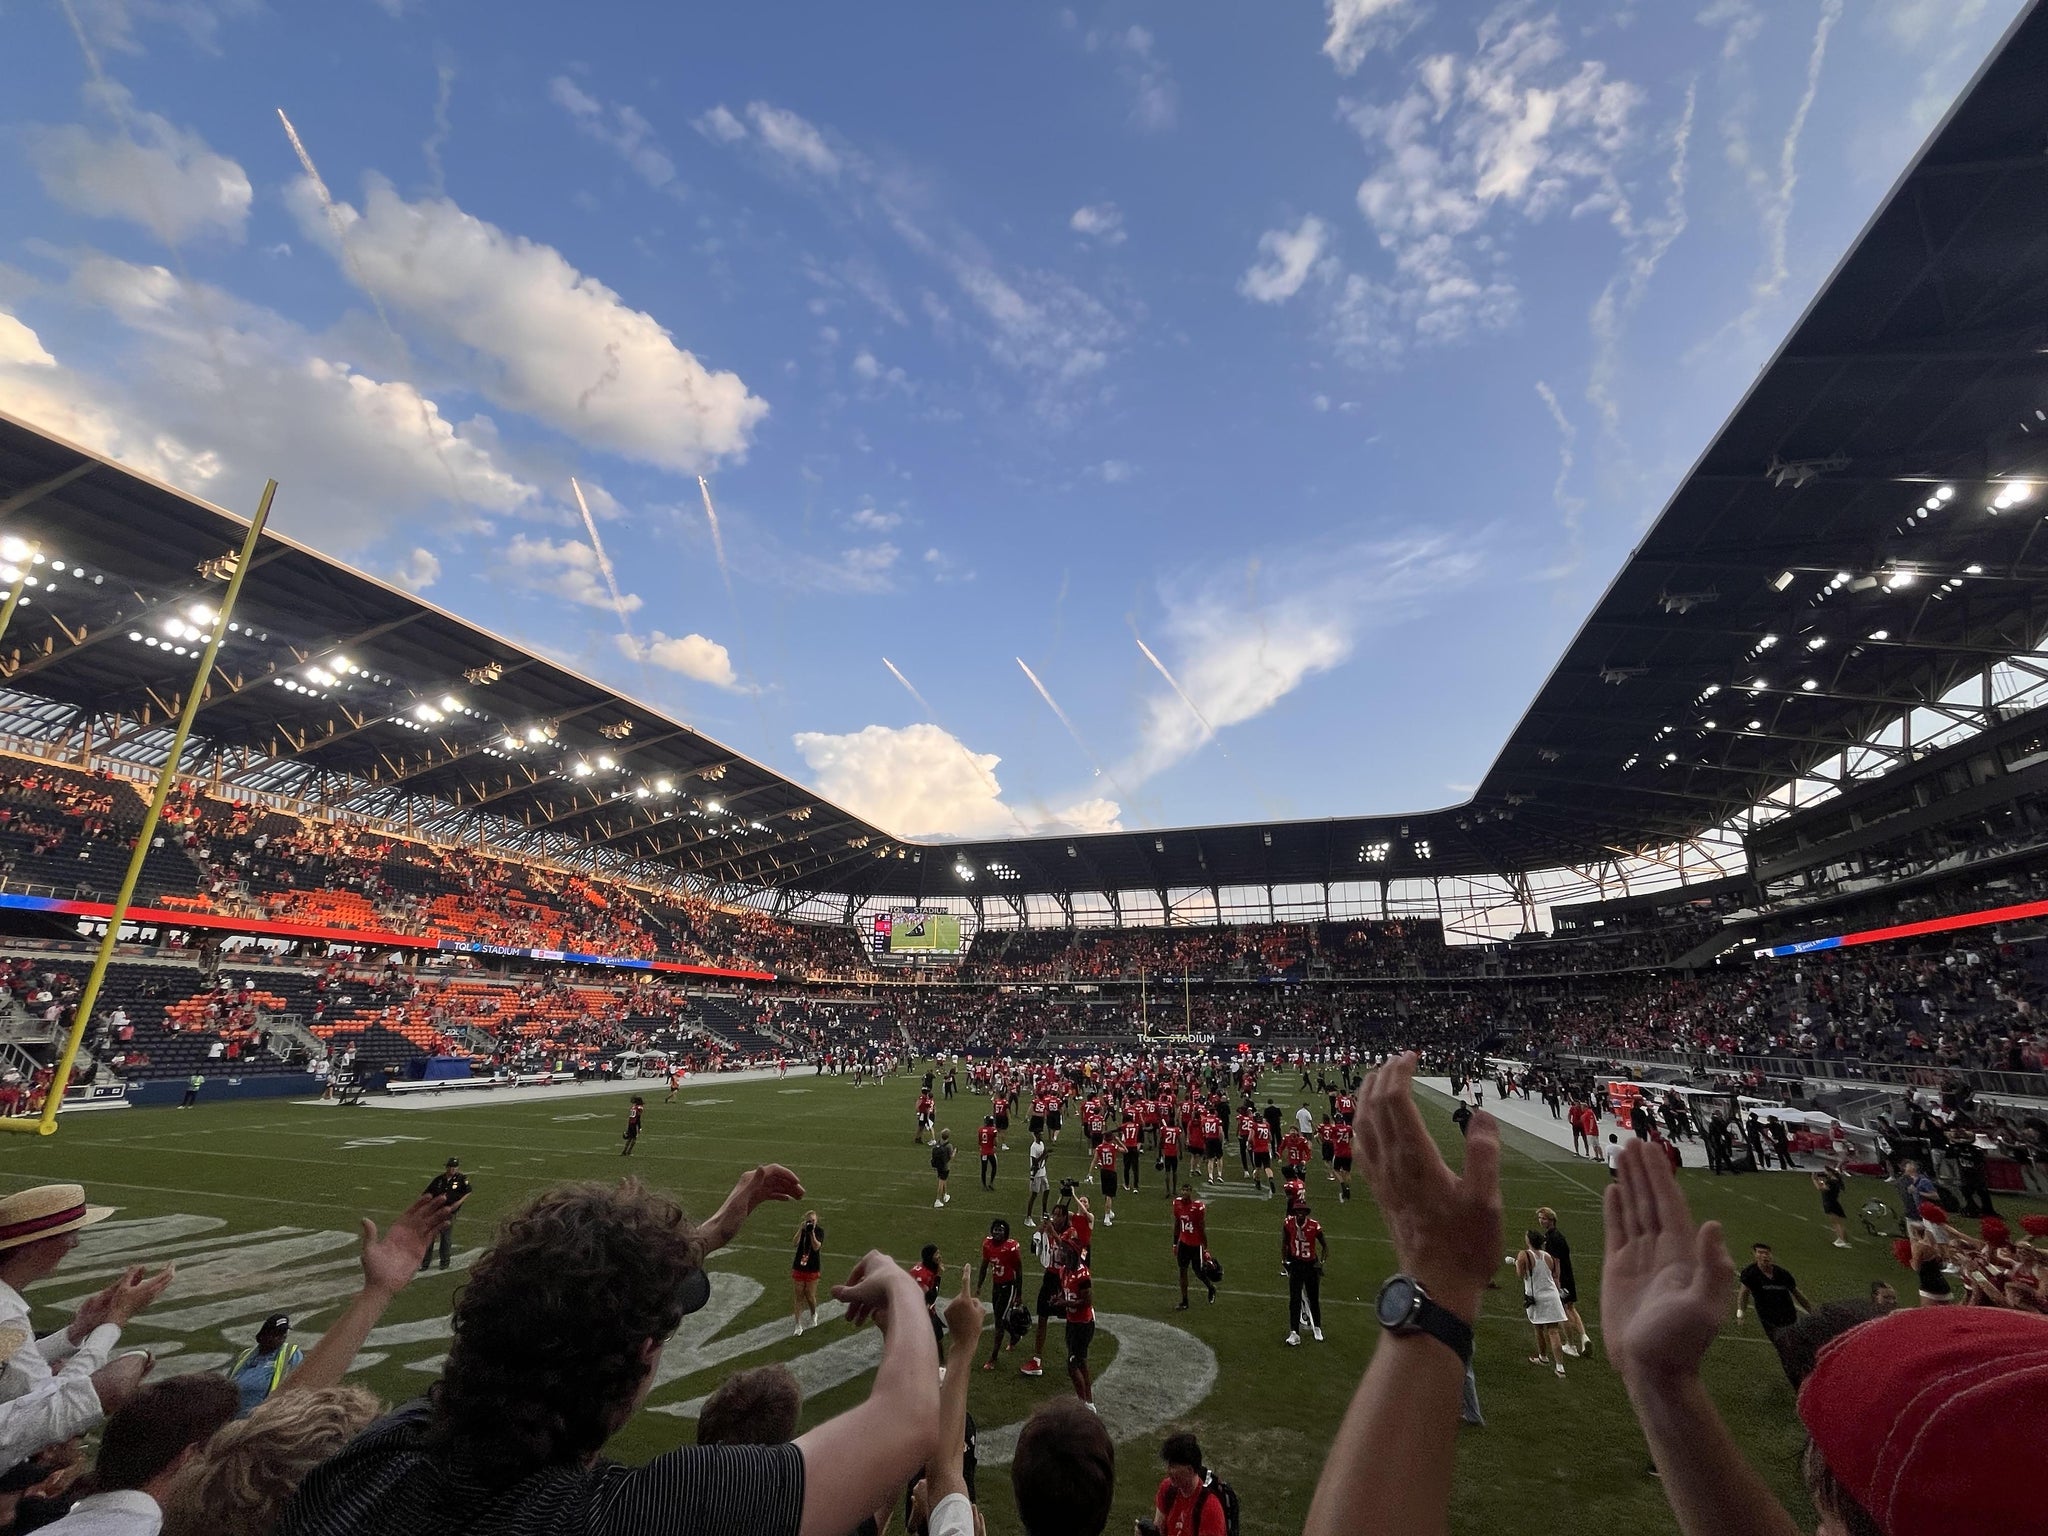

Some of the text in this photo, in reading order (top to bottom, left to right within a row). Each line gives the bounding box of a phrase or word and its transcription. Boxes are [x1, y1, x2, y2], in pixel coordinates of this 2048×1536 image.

[890, 906, 948, 915] TQL STADIUM
[455, 942, 520, 956] TQL STADIUM
[596, 956, 607, 964] 35
[1169, 1034, 1215, 1043] STADIUM
[1125, 1127, 1136, 1139] 17
[1204, 1122, 1217, 1134] 84
[1257, 1127, 1269, 1140] 78
[1164, 1131, 1177, 1145] 21
[1336, 1132, 1350, 1144] 74
[1101, 1152, 1113, 1165] 16
[1180, 1219, 1194, 1234] 14
[1294, 1240, 1312, 1259] 15
